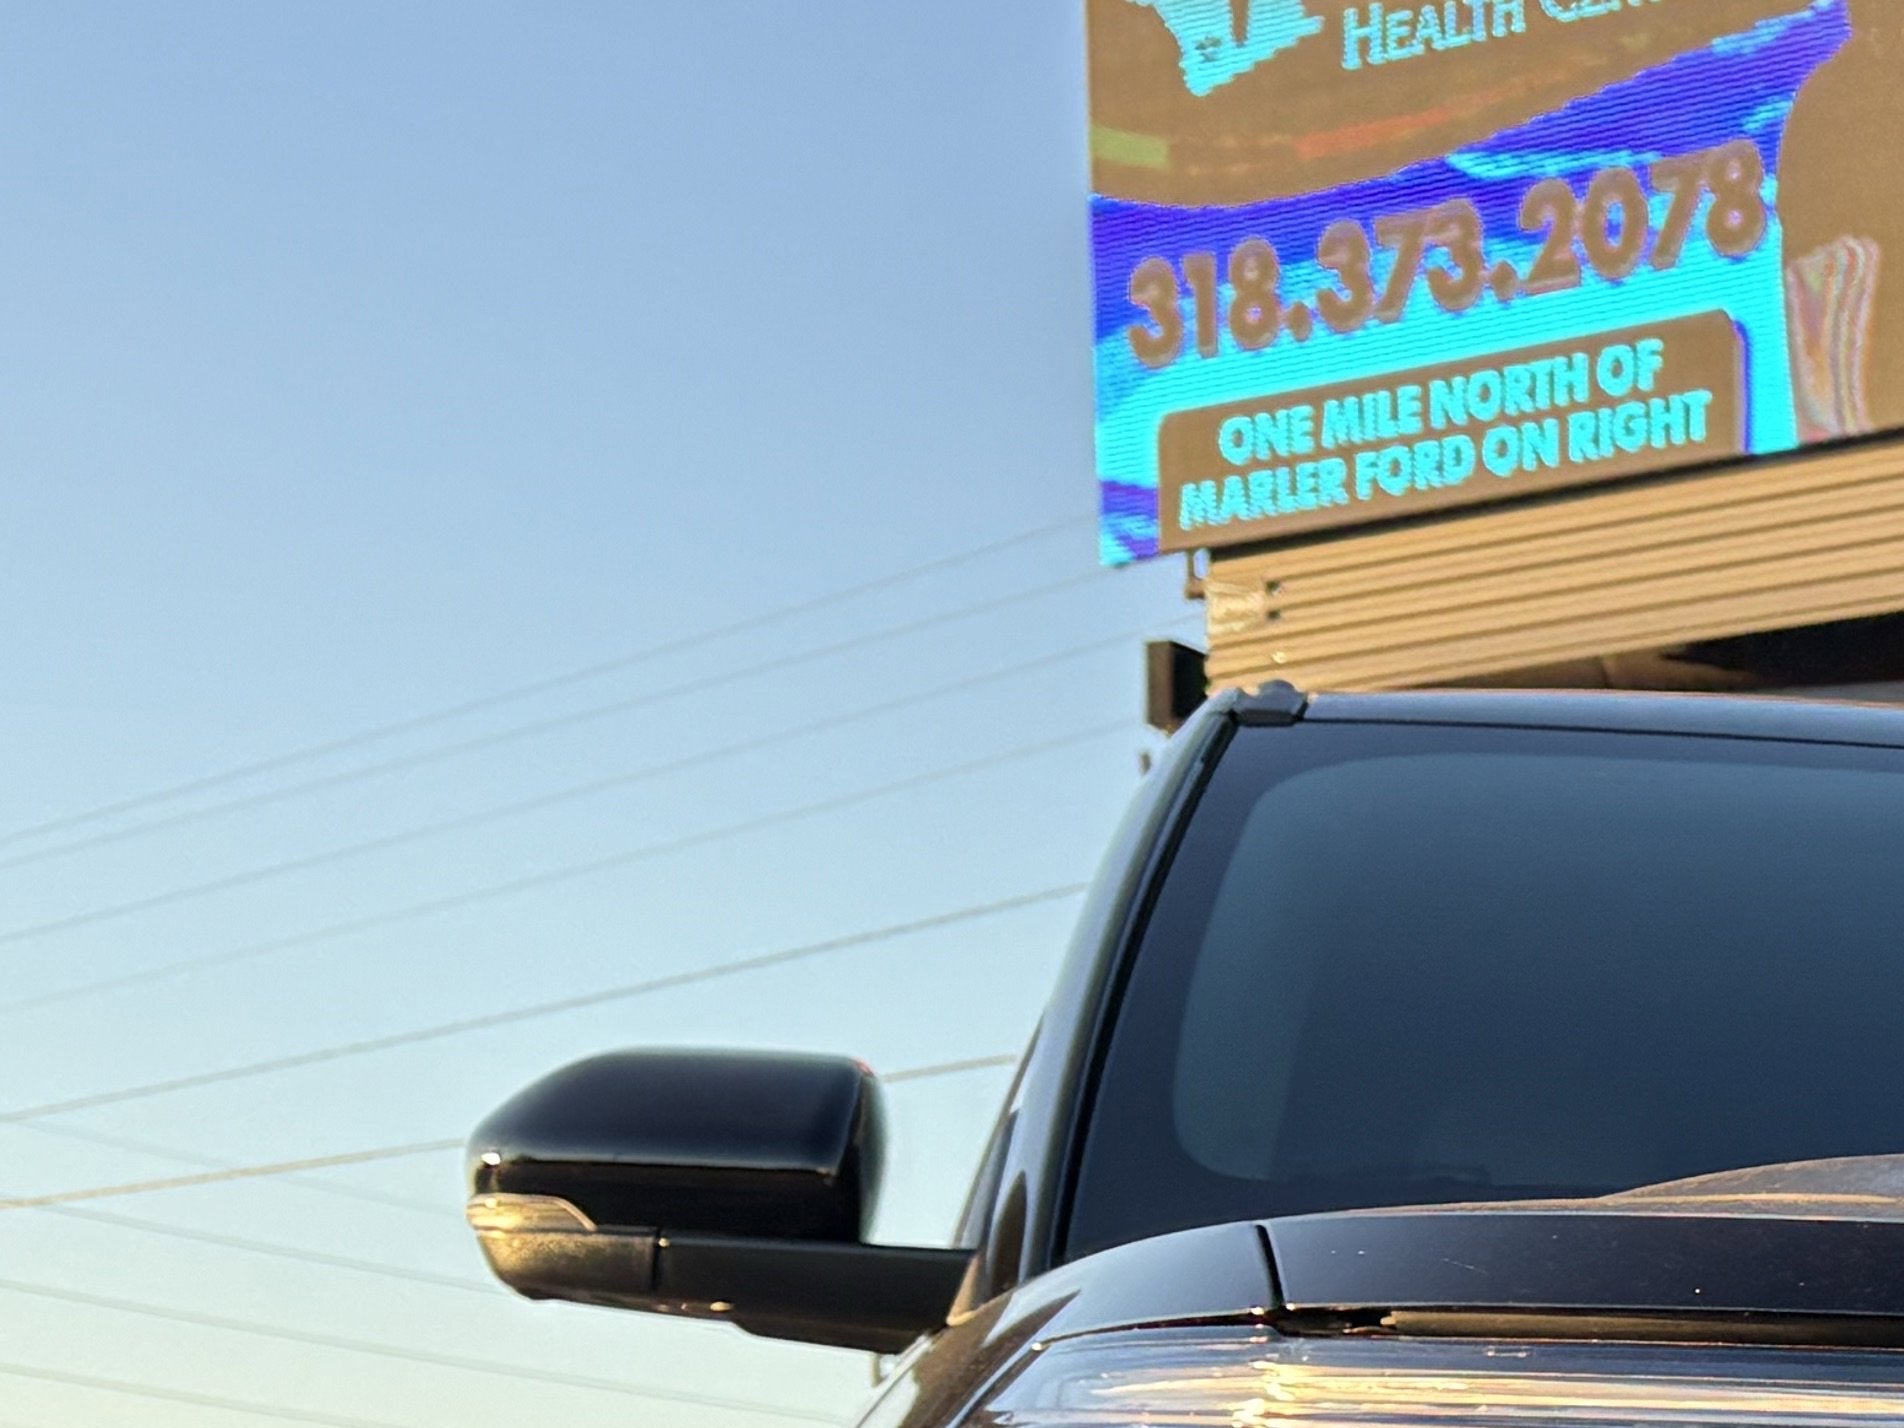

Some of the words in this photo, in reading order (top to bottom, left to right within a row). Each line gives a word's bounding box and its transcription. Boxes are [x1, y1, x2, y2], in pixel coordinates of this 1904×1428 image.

[1127, 139, 1766, 369] 318.373.2078
[1179, 457, 1349, 531] MARLER
[1355, 434, 1476, 500] FORD
[1482, 417, 1560, 477] ON
[1568, 390, 1712, 463] RIGHT
[1218, 405, 1314, 465] ONE
[1321, 384, 1423, 449] MILE
[1428, 352, 1588, 429] NORTH
[1596, 338, 1663, 396] OF
